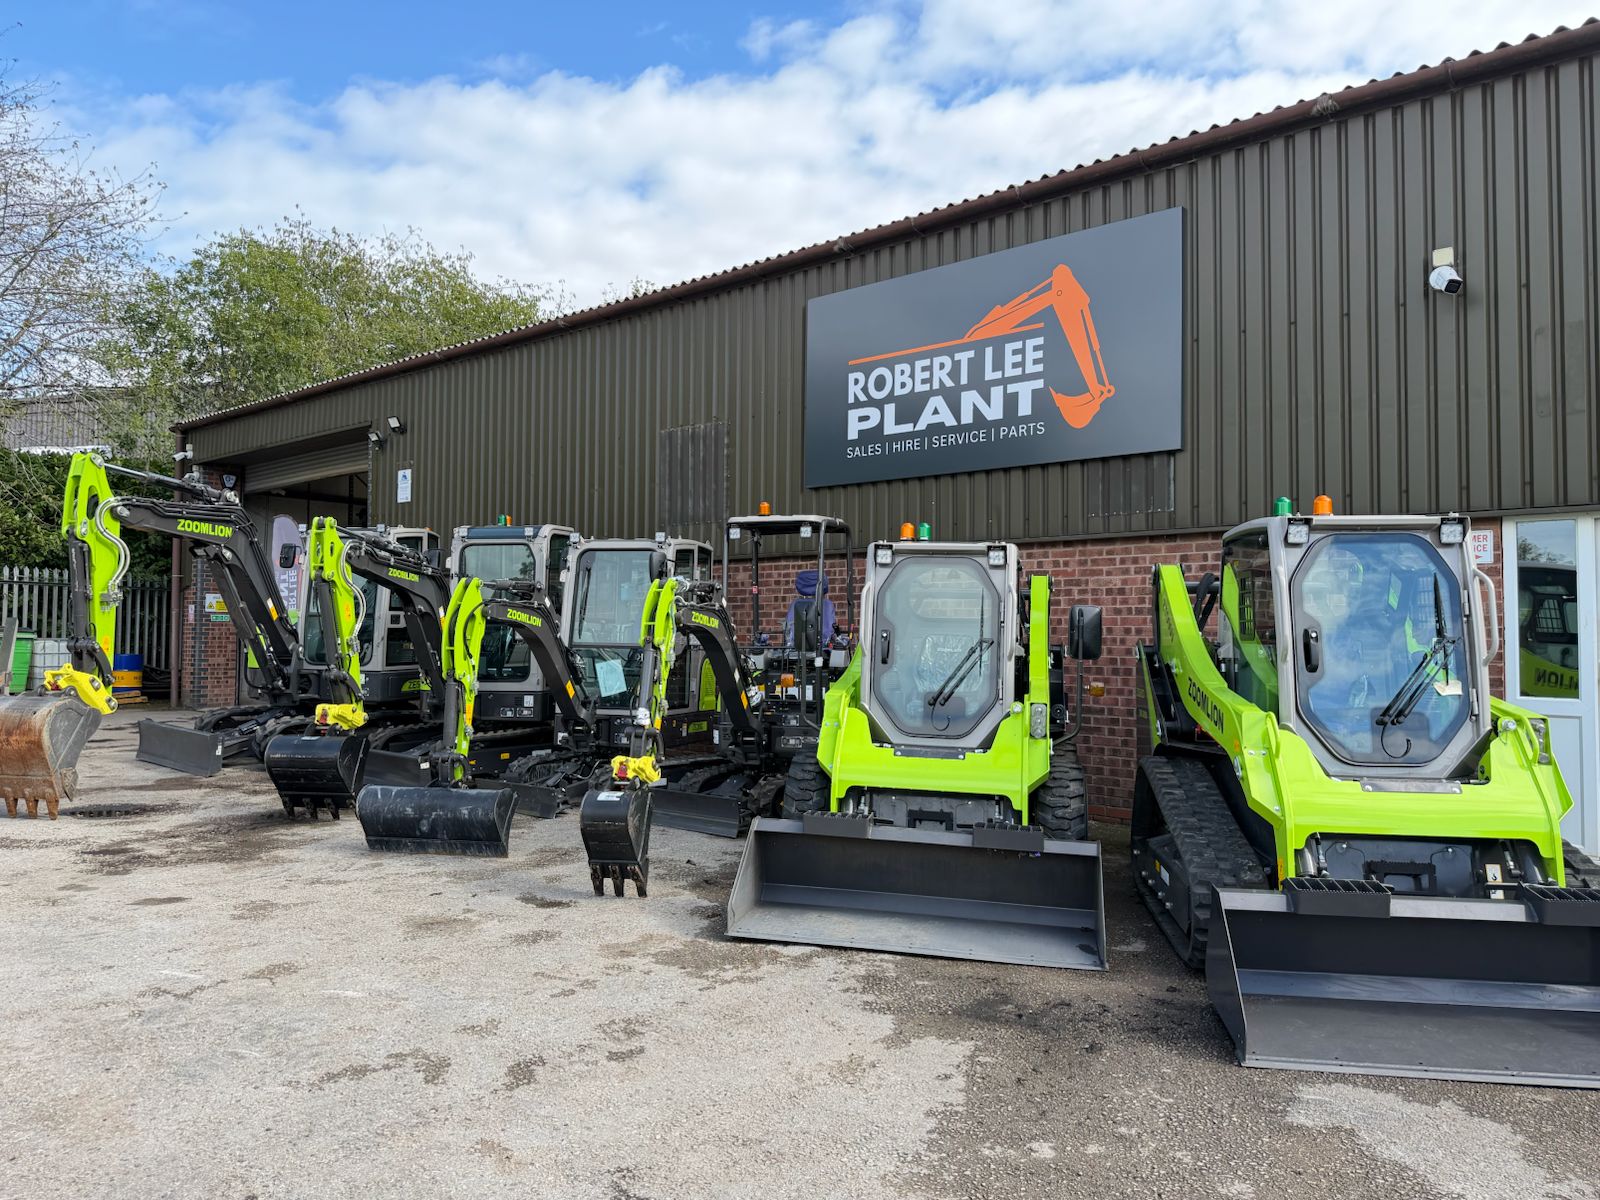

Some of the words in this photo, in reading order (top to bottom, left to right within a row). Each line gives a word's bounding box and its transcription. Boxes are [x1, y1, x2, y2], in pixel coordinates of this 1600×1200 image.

[848, 350, 975, 404] ROBERT
[984, 336, 1044, 380] LEE
[847, 379, 1044, 441] PLANT
[846, 443, 882, 458] SALES
[893, 438, 920, 453] HIRE
[932, 429, 988, 448] SERVICE
[1000, 422, 1045, 438] PARTS
[176, 518, 233, 538] ZOOMLION
[388, 567, 420, 582] ZOOMLION
[507, 608, 542, 627] ZOOMLION
[691, 611, 719, 629] ZOOMLION
[1188, 677, 1224, 734] ZOOMLION
